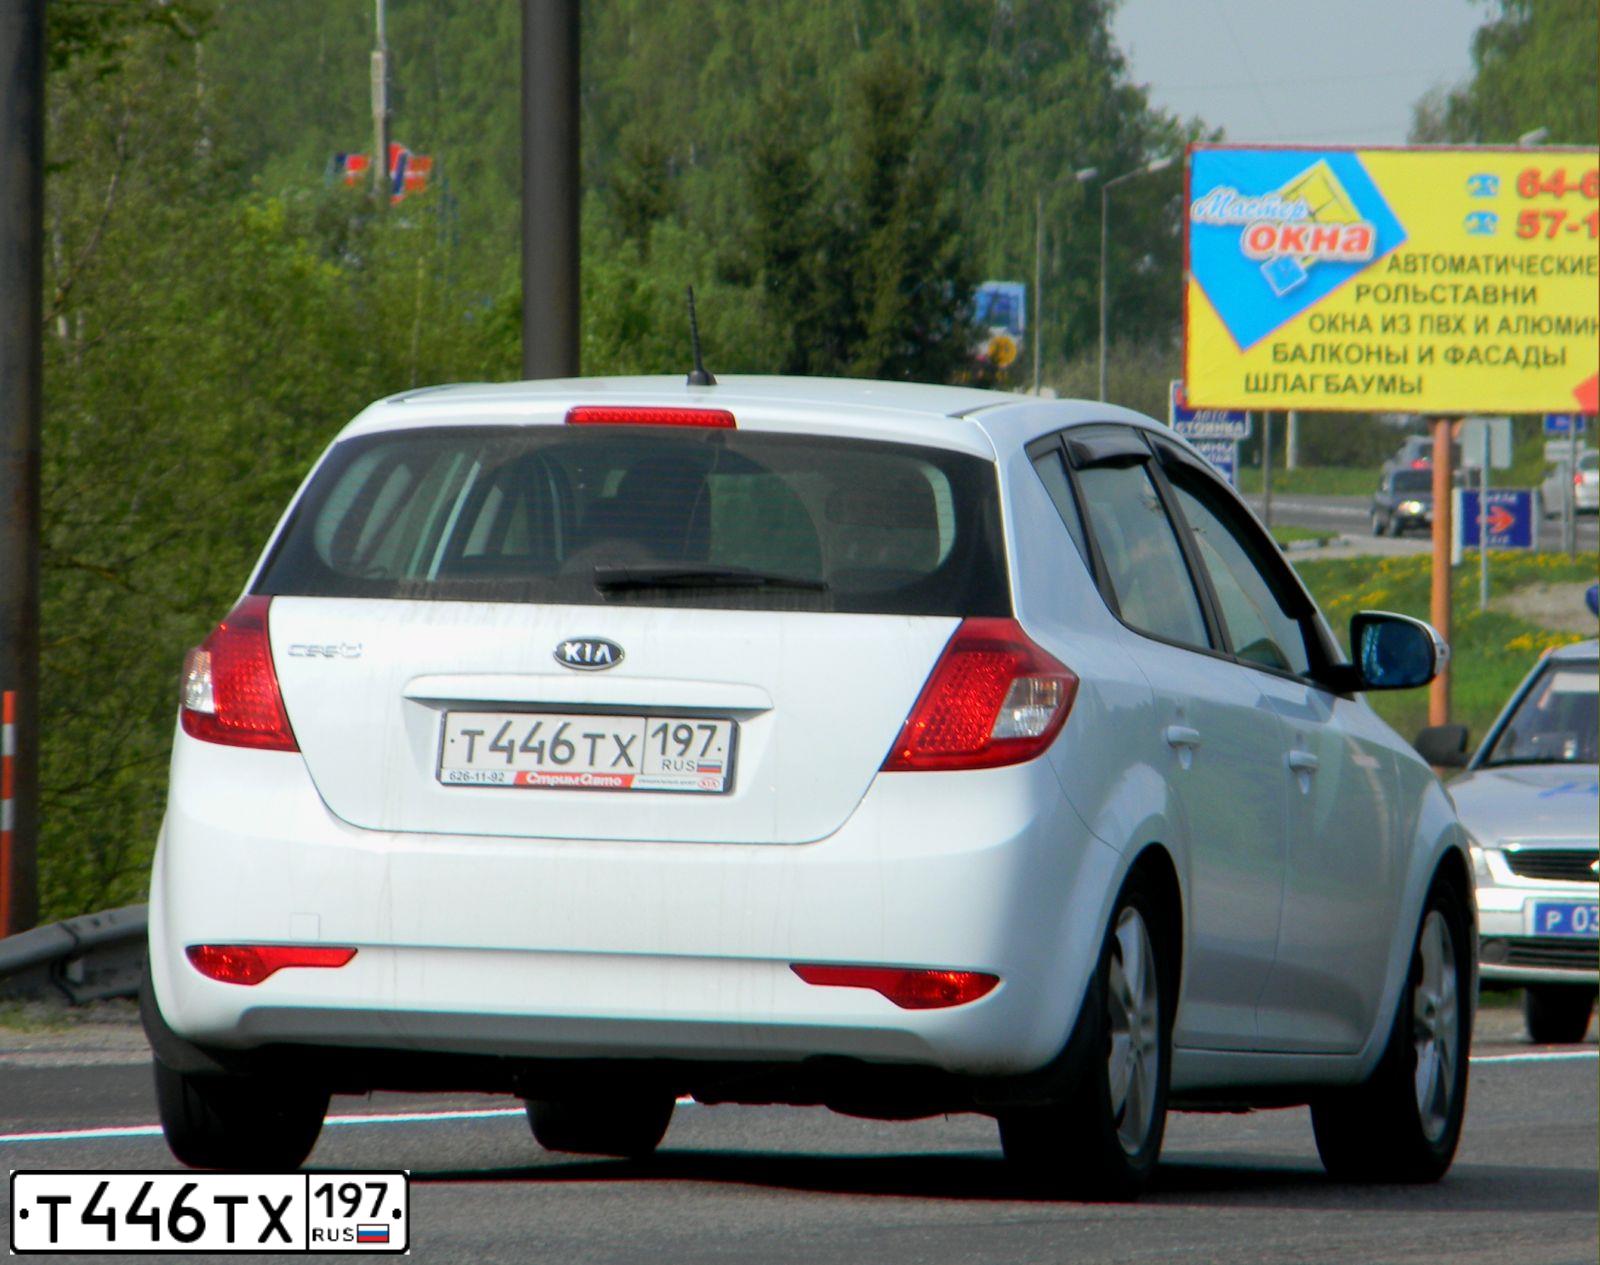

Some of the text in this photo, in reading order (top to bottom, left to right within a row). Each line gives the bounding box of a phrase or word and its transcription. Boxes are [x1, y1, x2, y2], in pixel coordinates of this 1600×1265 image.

[1386, 254, 1598, 275] АВТОМАТИЧЕСКИЕ
[1355, 283, 1538, 305] РОЛЬСТАВНИ
[1308, 313, 1373, 334] ОКНА
[1381, 314, 1411, 334] ИЗ
[1418, 314, 1466, 335] ПВХ
[1475, 315, 1489, 335] И
[1272, 342, 1567, 369] БАЛКОНЫ И ФАСАДЫ
[1244, 373, 1423, 395] ШЛАГБАУМЫ
[564, 642, 614, 664] KIA
[651, 722, 717, 757] 197
[661, 758, 696, 772] RUS
